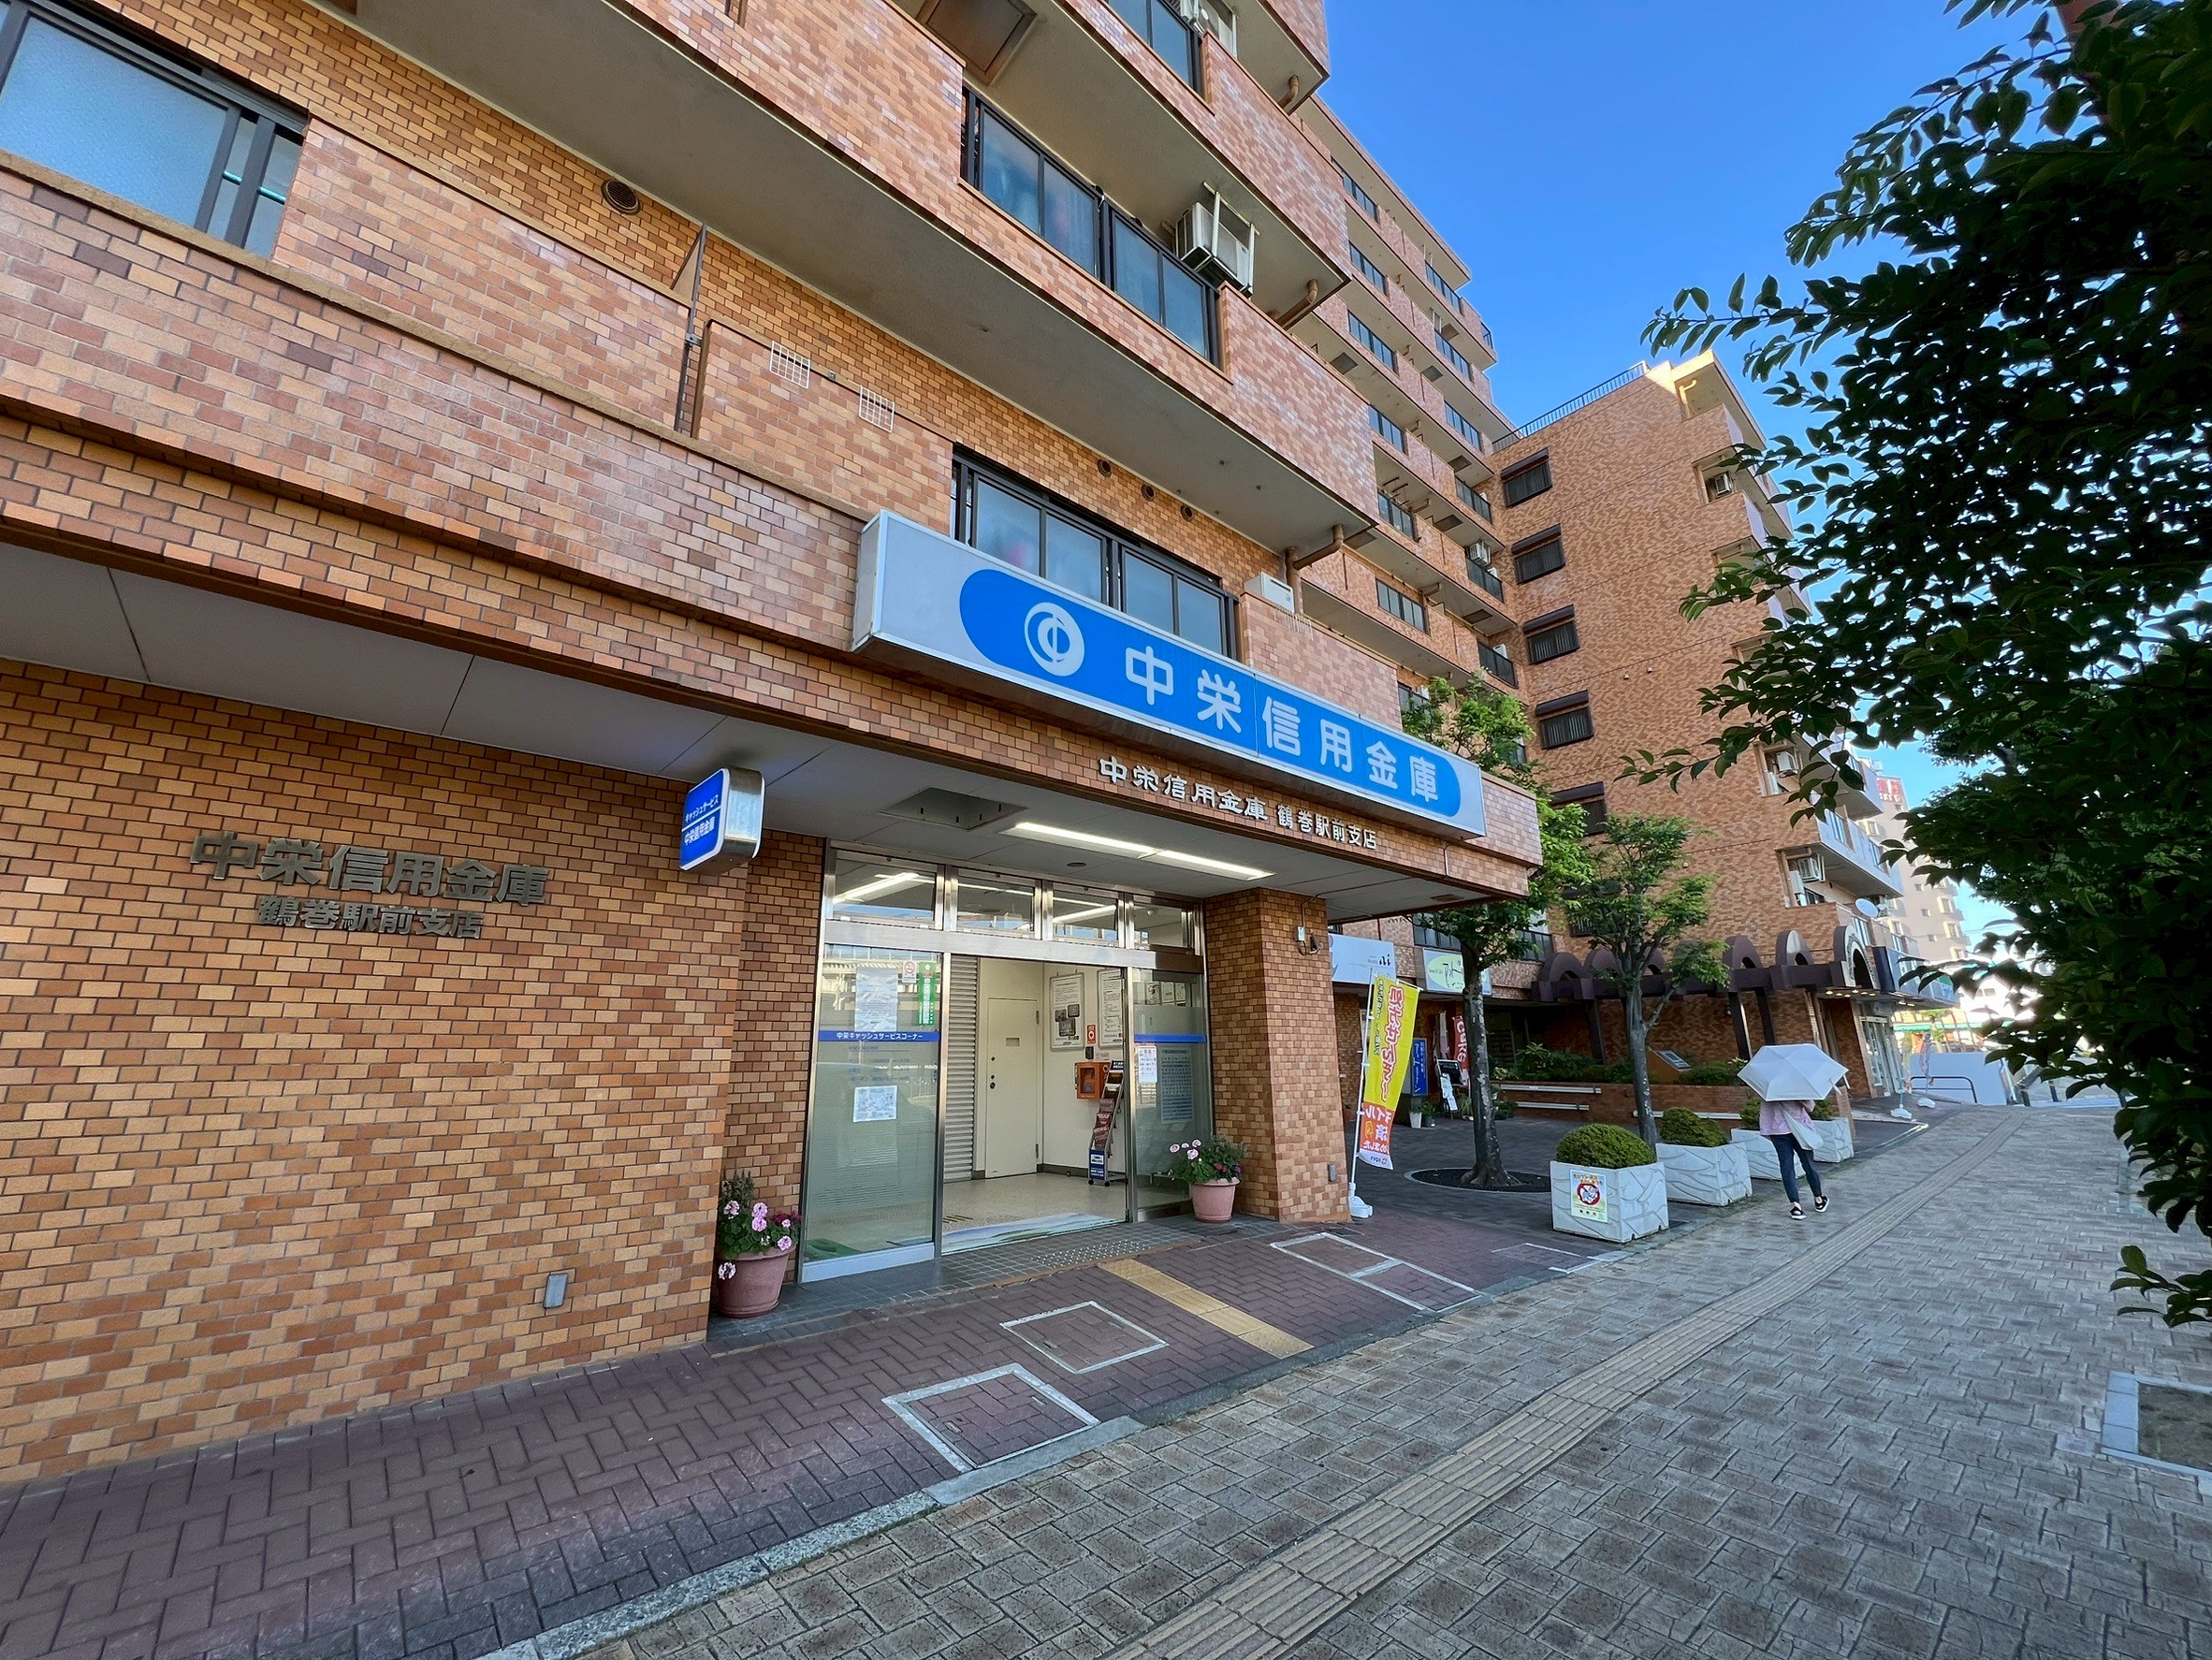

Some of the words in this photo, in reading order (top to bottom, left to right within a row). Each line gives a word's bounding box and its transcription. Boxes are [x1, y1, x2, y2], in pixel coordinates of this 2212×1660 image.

[1124, 645, 1439, 803] 中栄信用金庫
[685, 794, 719, 823] キャッシュサービス
[1099, 756, 1268, 823] 中栄信用金庫
[1276, 804, 1377, 850] 鶴巻駅前支店
[190, 831, 549, 907] 中栄信用金庫
[257, 895, 485, 939] 鶴巻駅前支店
[836, 1031, 924, 1041] 中栄キャッシュサービスコーナー
